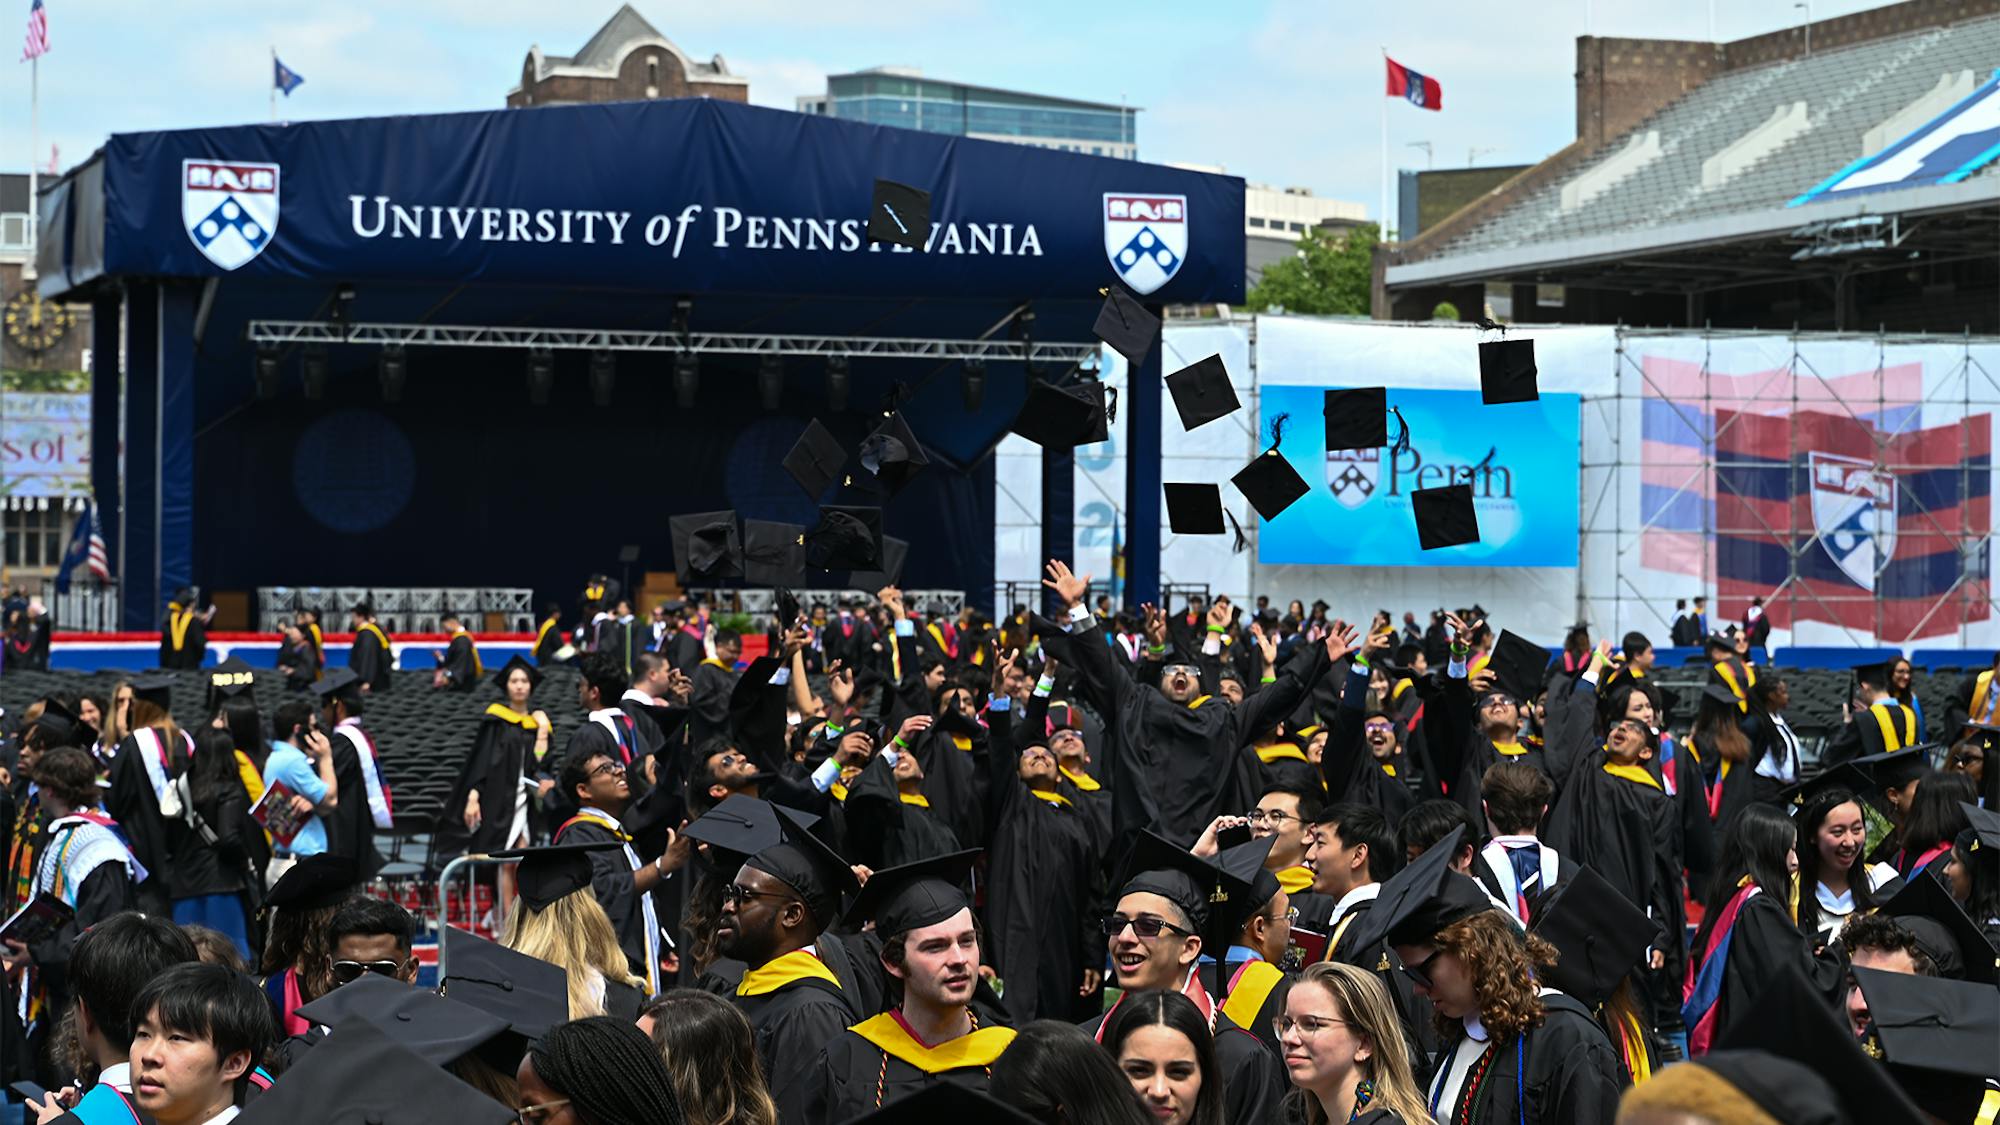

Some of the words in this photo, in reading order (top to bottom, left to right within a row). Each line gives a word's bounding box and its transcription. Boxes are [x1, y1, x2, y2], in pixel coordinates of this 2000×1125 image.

[348, 194, 632, 244] UNIVERSITY
[644, 204, 703, 259] of
[712, 206, 1044, 256] PENNSVANIA
[1384, 445, 1515, 499] Penn
